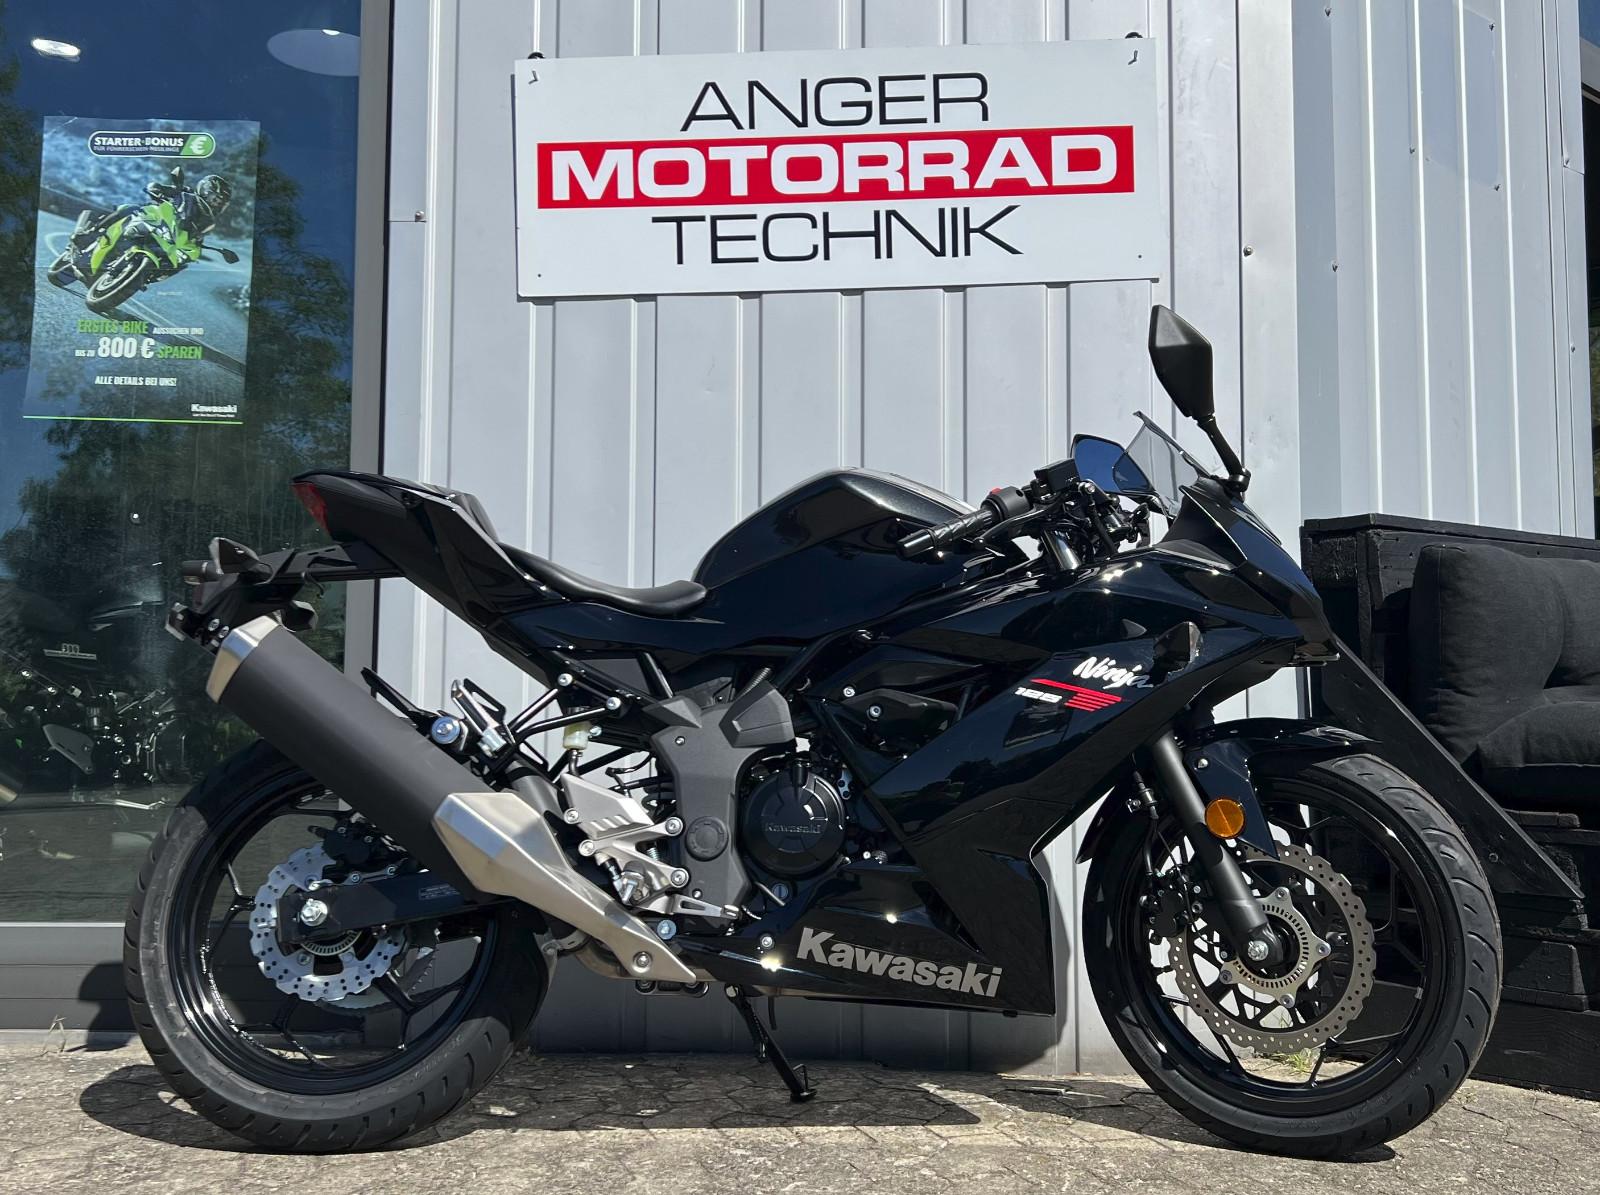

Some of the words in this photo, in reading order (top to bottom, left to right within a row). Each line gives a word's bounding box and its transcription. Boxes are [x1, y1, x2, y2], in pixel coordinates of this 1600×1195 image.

[681, 72, 989, 131] ANGER
[551, 134, 1118, 200] MOTORRAD
[652, 205, 1024, 265] TECHNIK
[77, 319, 119, 334] ERSTES
[122, 320, 149, 335] BIKE
[97, 337, 137, 358] 800
[140, 337, 155, 358] €
[157, 346, 203, 359] SPAREN
[94, 376, 113, 385] ALLE
[114, 376, 143, 386] DETAILS
[145, 377, 157, 386] BEI
[191, 403, 238, 413] Kawasaki
[1073, 656, 1154, 690] Ninja
[796, 927, 1002, 997] Kawasaki
